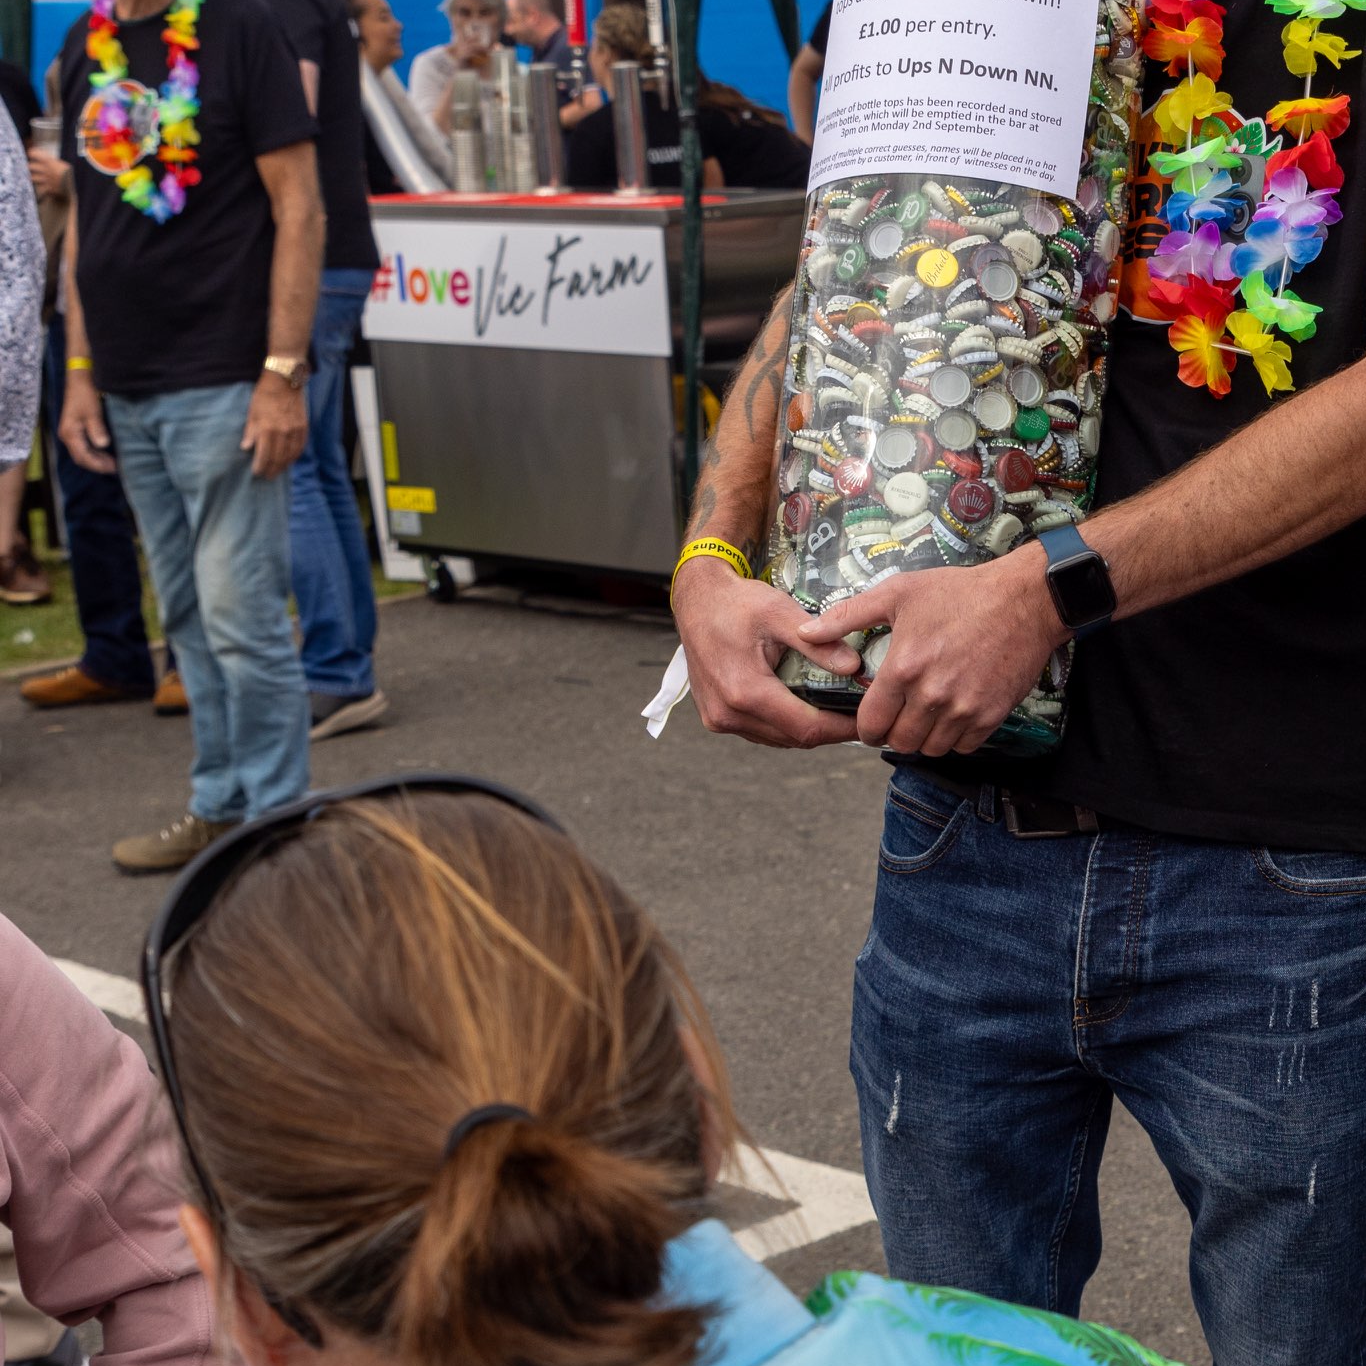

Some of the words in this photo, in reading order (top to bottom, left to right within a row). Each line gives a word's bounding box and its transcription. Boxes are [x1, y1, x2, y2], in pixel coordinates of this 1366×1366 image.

[858, 17, 901, 40] £1.00
[905, 19, 937, 37] per
[941, 19, 997, 40] entry.
[833, 64, 872, 92] profits
[876, 61, 893, 76] to
[897, 57, 932, 78] Ups
[938, 57, 953, 74] N
[959, 59, 1018, 83] Down
[1024, 68, 1059, 92] NN.
[839, 114, 862, 127] bottle,
[863, 109, 889, 122] which
[891, 108, 910, 118] will
[911, 108, 925, 118] be
[926, 109, 972, 122] emptied
[975, 112, 985, 123] in
[988, 114, 1006, 126] the
[1008, 117, 1027, 130] bar
[1029, 121, 1040, 133] at
[848, 102, 857, 114] of
[857, 98, 882, 112] bottle
[884, 98, 904, 109] tops
[906, 96, 925, 107] has
[927, 96, 954, 107] been
[956, 100, 1007, 114] recorded
[1008, 107, 1029, 118] and
[1030, 111, 1063, 127] stored
[840, 125, 857, 138] 3pm
[858, 124, 869, 134] on
[870, 120, 910, 132] Monday
[912, 120, 932, 131] 2nd
[934, 121, 997, 137] September.
[857, 157, 867, 165] by
[873, 154, 913, 163] customer,
[915, 153, 924, 162] in
[925, 153, 949, 164] front
[949, 154, 962, 165] of
[964, 157, 1008, 171] witnesses
[1009, 164, 1022, 174] on
[1023, 166, 1038, 178] the
[1038, 170, 1057, 183] day.
[864, 144, 891, 155] correct
[892, 143, 928, 154] guesses,
[930, 145, 960, 154] names
[962, 147, 980, 157] will
[980, 148, 993, 158] be
[993, 152, 1024, 164] placed
[1025, 156, 1034, 166] in
[1042, 161, 1057, 172] hat
[371, 253, 471, 307] #love
[541, 234, 653, 326] Farm
[692, 541, 749, 579] supporting
